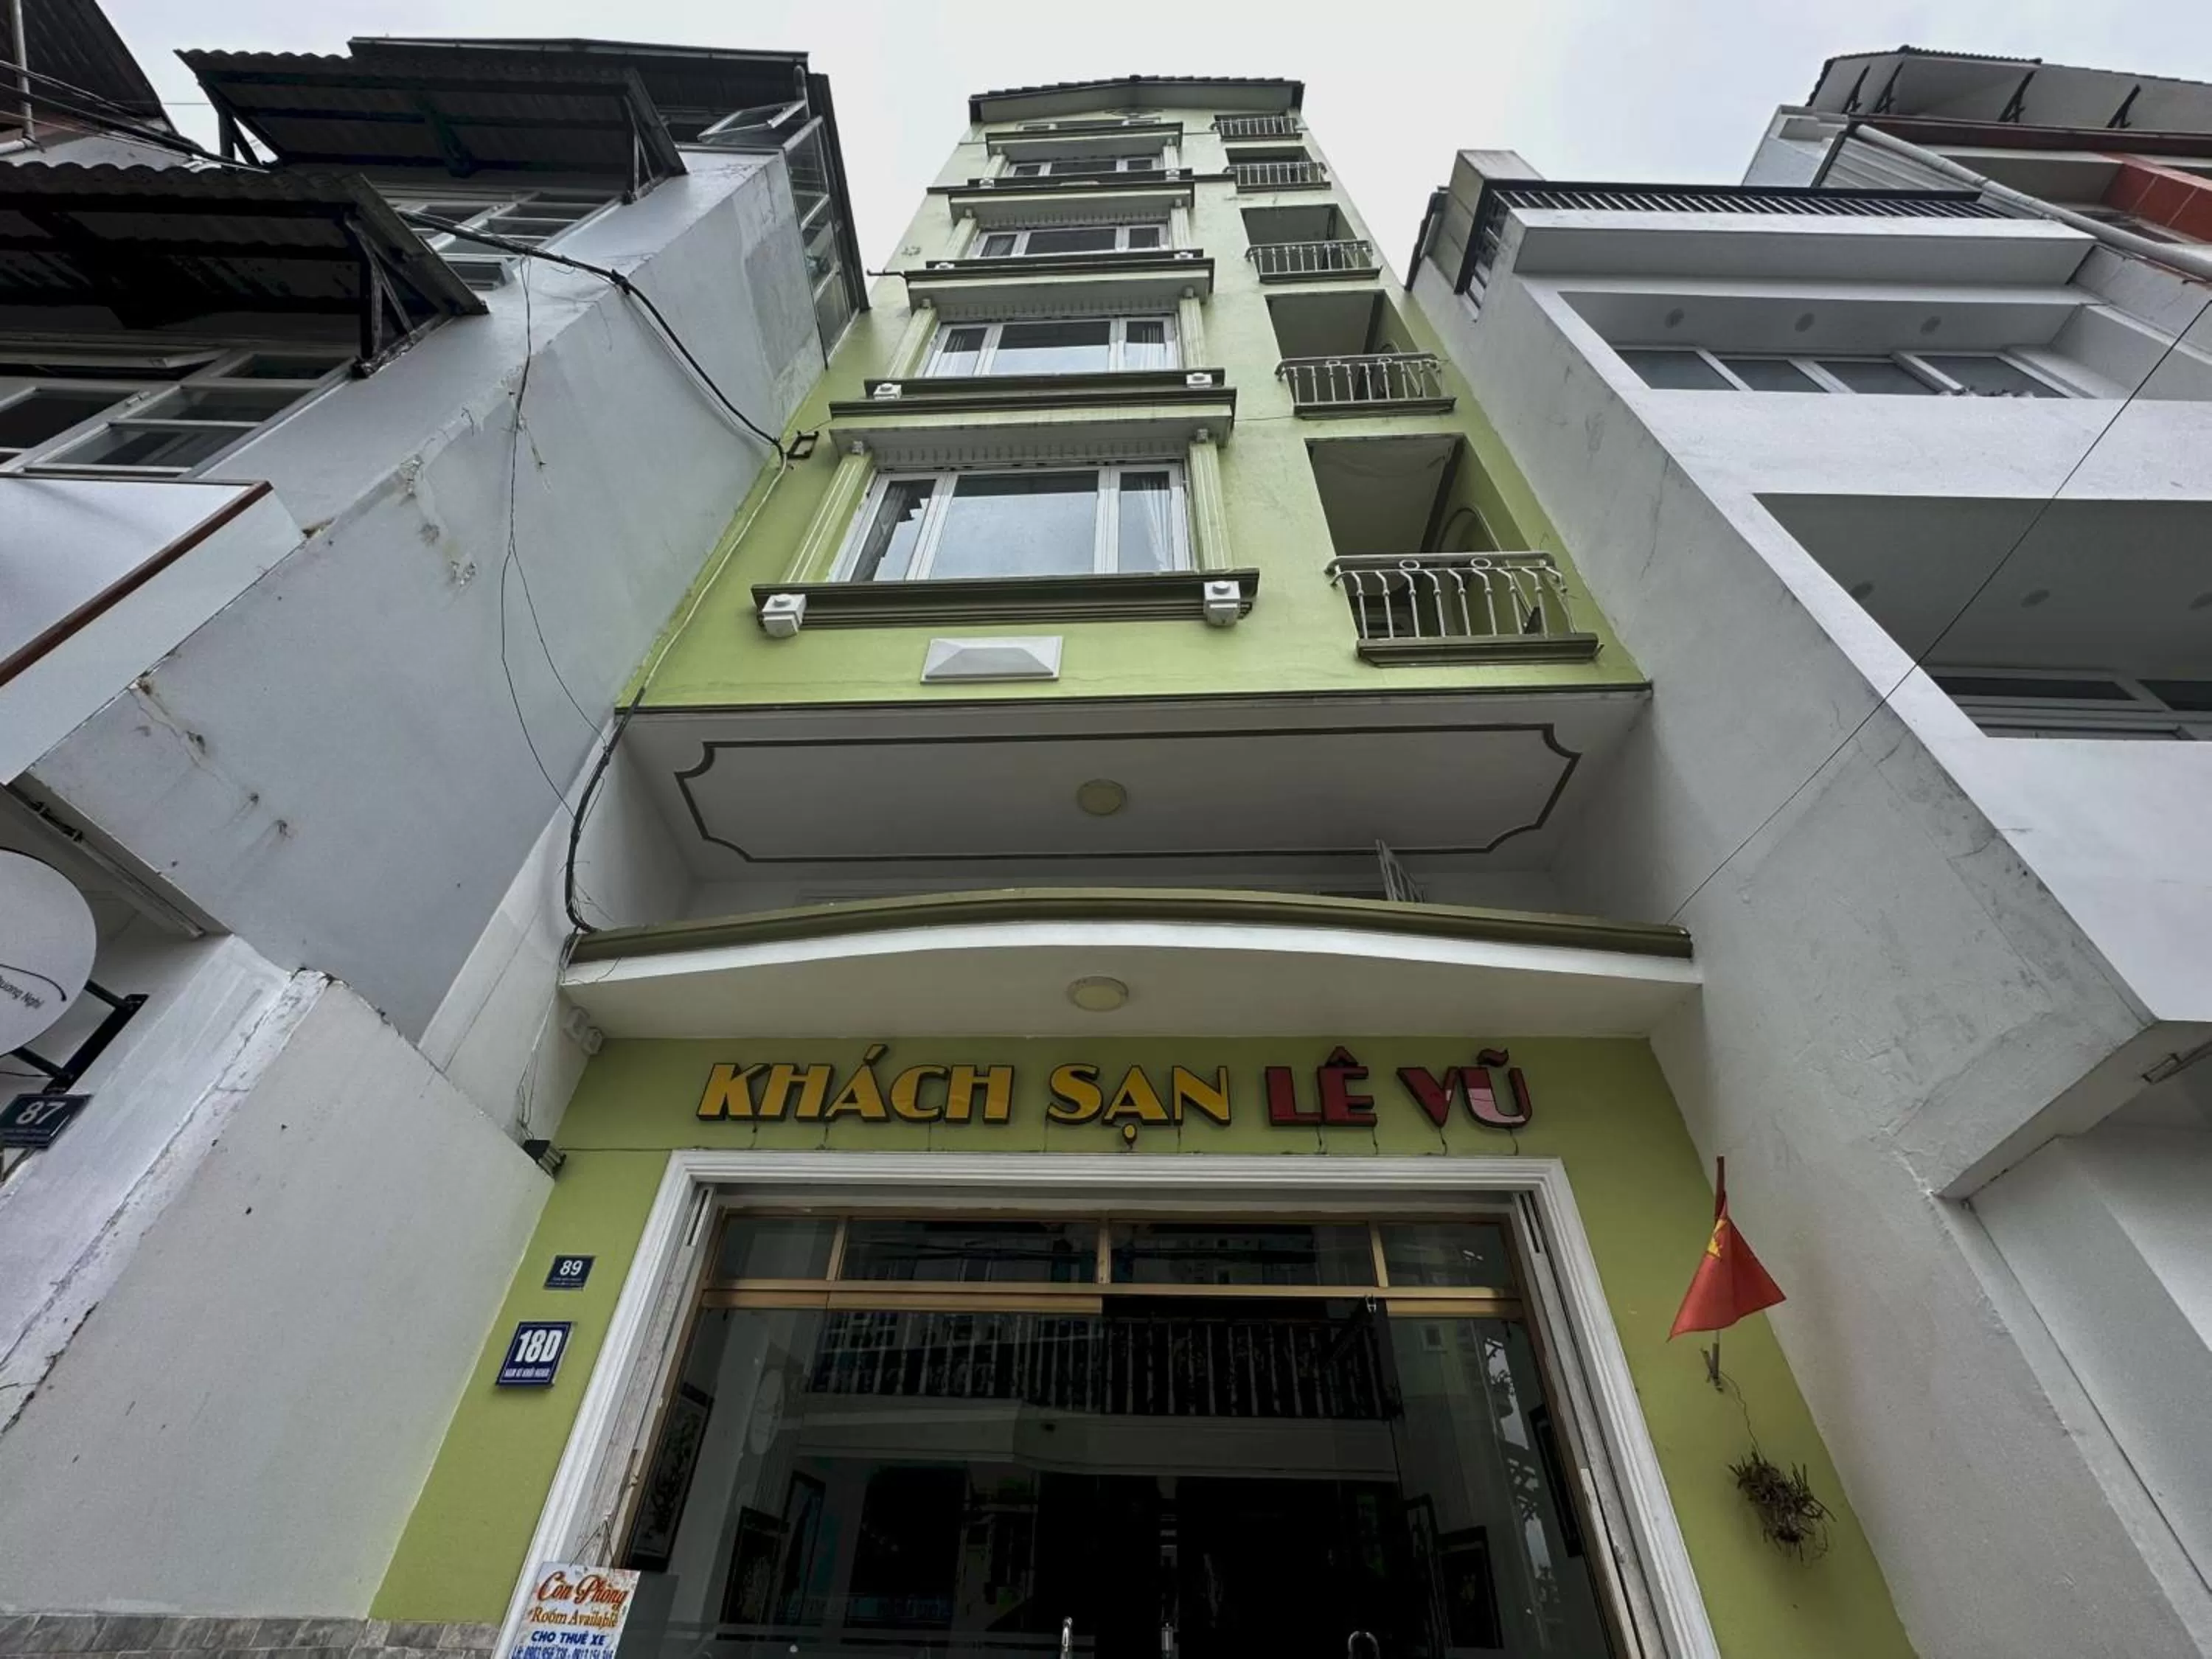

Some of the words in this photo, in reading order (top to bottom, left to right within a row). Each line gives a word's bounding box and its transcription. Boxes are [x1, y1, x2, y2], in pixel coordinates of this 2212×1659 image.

[695, 1043, 1015, 1124] KHÁCH
[1046, 1062, 1231, 1145] SẠN
[1265, 1046, 1377, 1127] LÊ
[1396, 1047, 1533, 1128] VŨ
[15, 1100, 66, 1124] 87
[560, 1259, 583, 1276] 89
[514, 1329, 563, 1363] 18D
[529, 1607, 569, 1624] Room
[531, 1630, 556, 1642] CHO
[591, 1634, 607, 1646] XE
